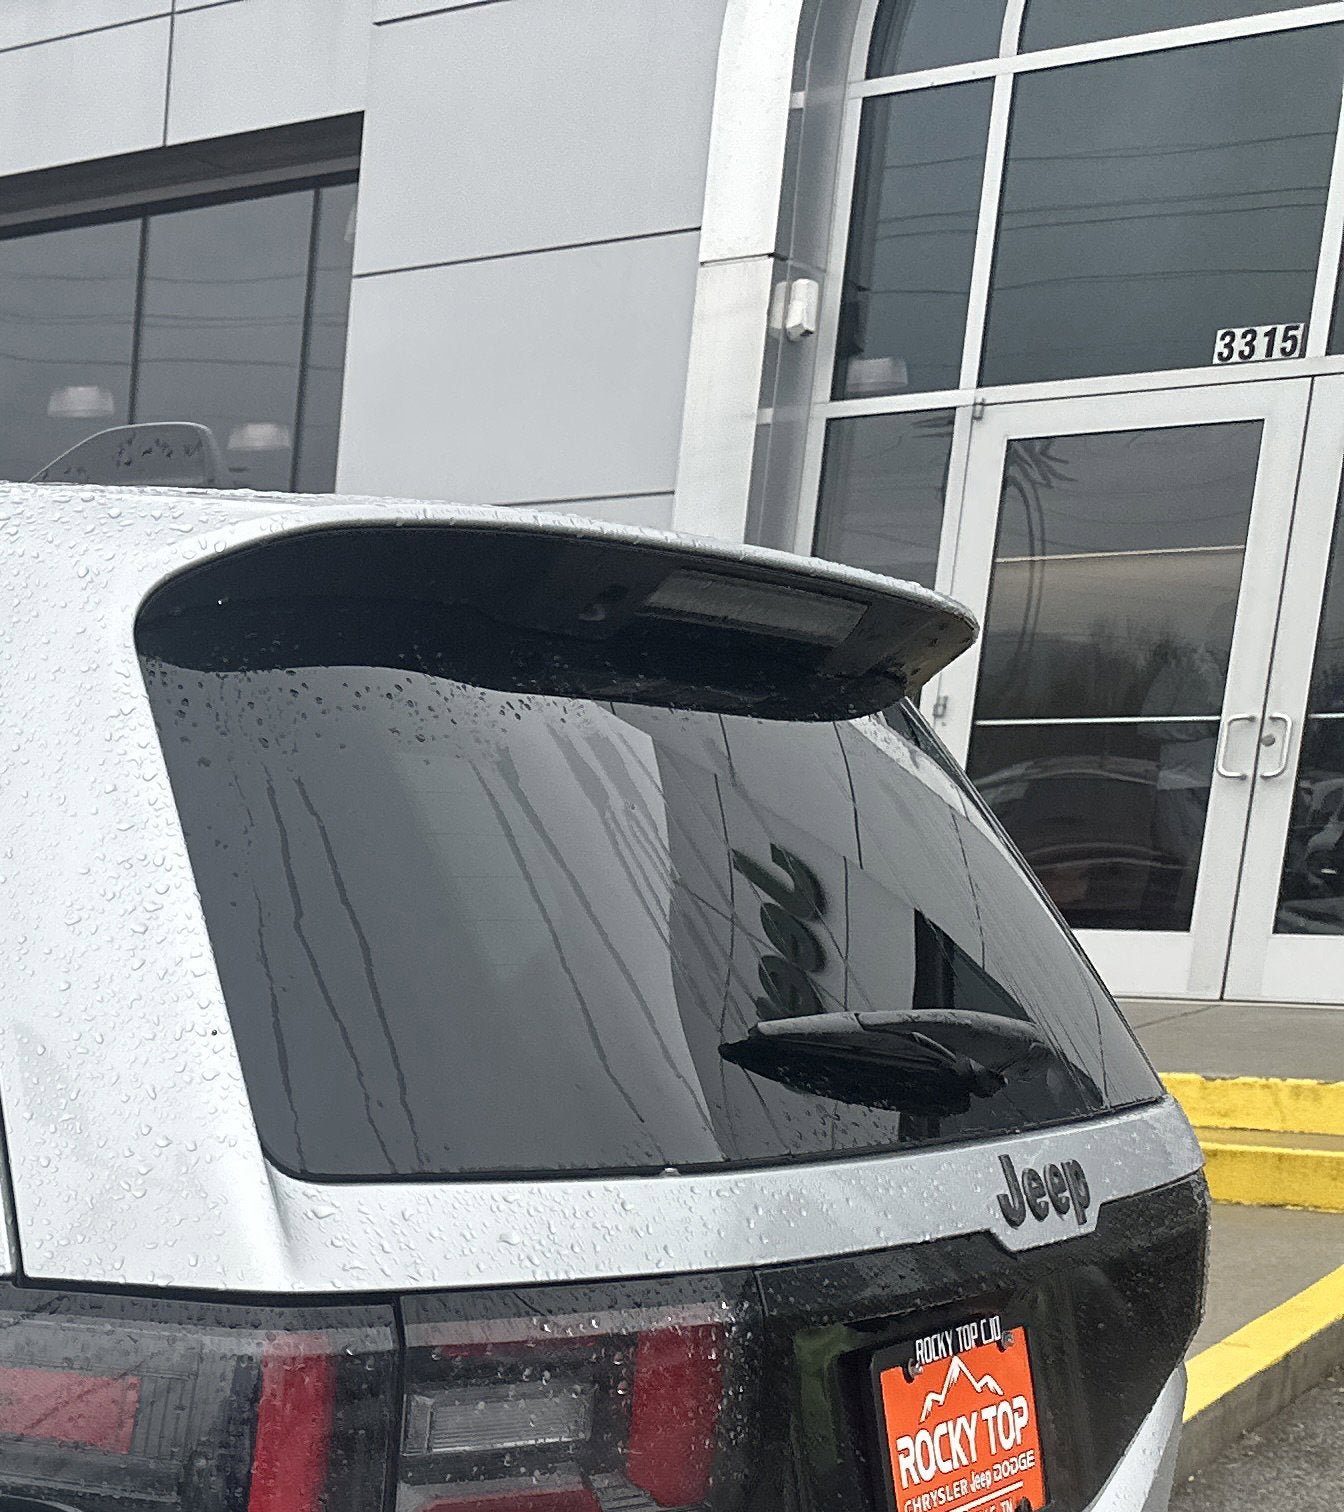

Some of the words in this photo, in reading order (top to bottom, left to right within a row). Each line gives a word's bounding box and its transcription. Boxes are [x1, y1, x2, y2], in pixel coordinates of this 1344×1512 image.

[1217, 325, 1301, 362] 3315
[997, 1154, 1091, 1230] Jeep
[915, 1329, 953, 1365] ROCKY
[956, 1322, 978, 1353] TOP
[896, 1411, 978, 1490] ROCKY
[981, 1395, 1029, 1456] TOP
[970, 1469, 992, 1493] Jeep
[992, 1449, 1035, 1483] DODGE
